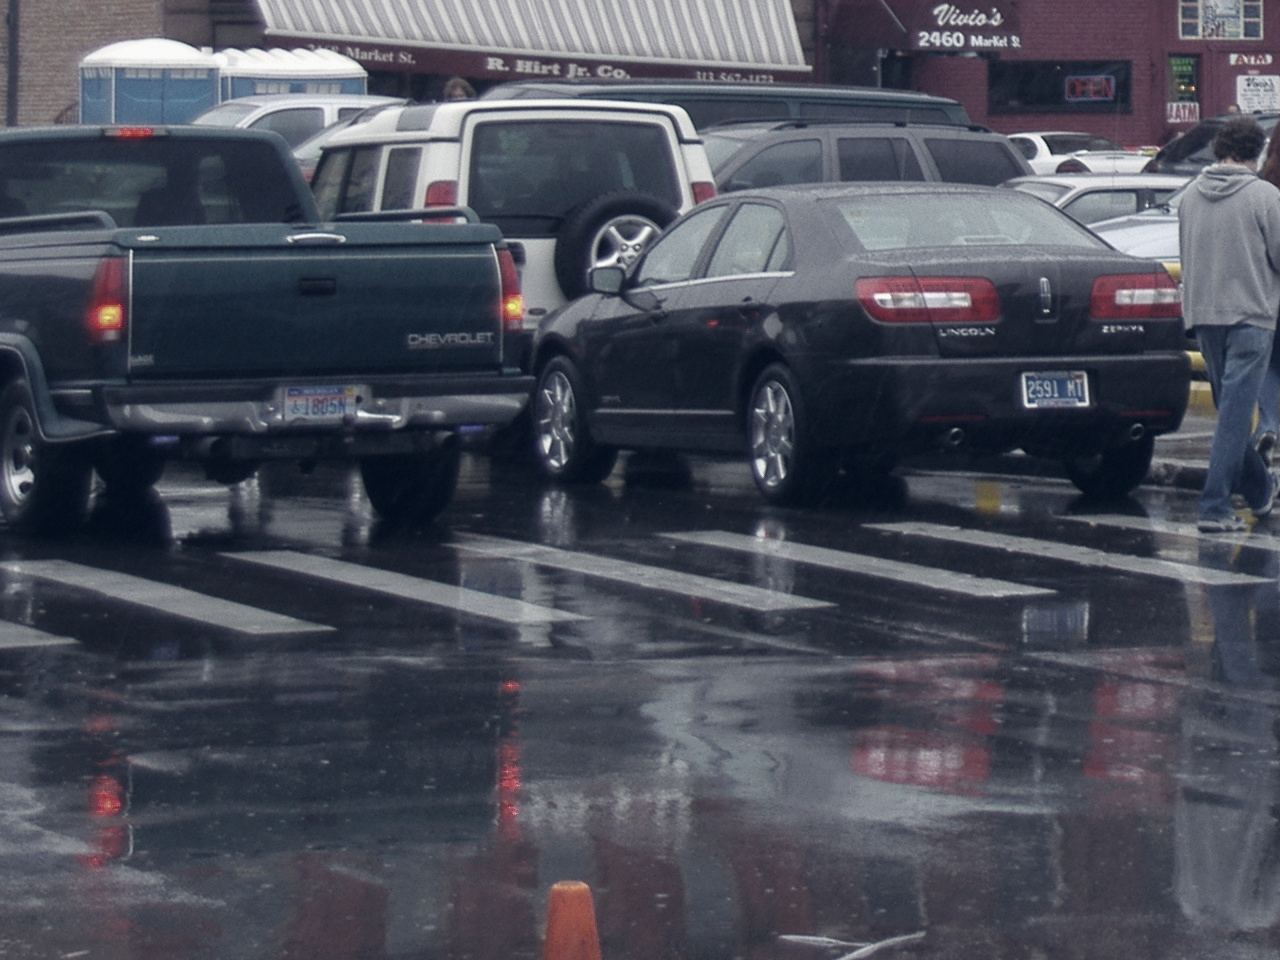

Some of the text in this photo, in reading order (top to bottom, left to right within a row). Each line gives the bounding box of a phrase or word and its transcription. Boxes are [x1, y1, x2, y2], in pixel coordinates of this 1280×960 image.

[933, 3, 1004, 27] Vivio's
[918, 31, 965, 48] 2460
[347, 46, 395, 63] Market
[399, 50, 416, 65] St.
[487, 56, 631, 80] R. Hirt Jr. Co.
[407, 331, 494, 346] CHEVROLET
[939, 327, 996, 337] LINCOLN
[1027, 380, 1059, 399] 2591
